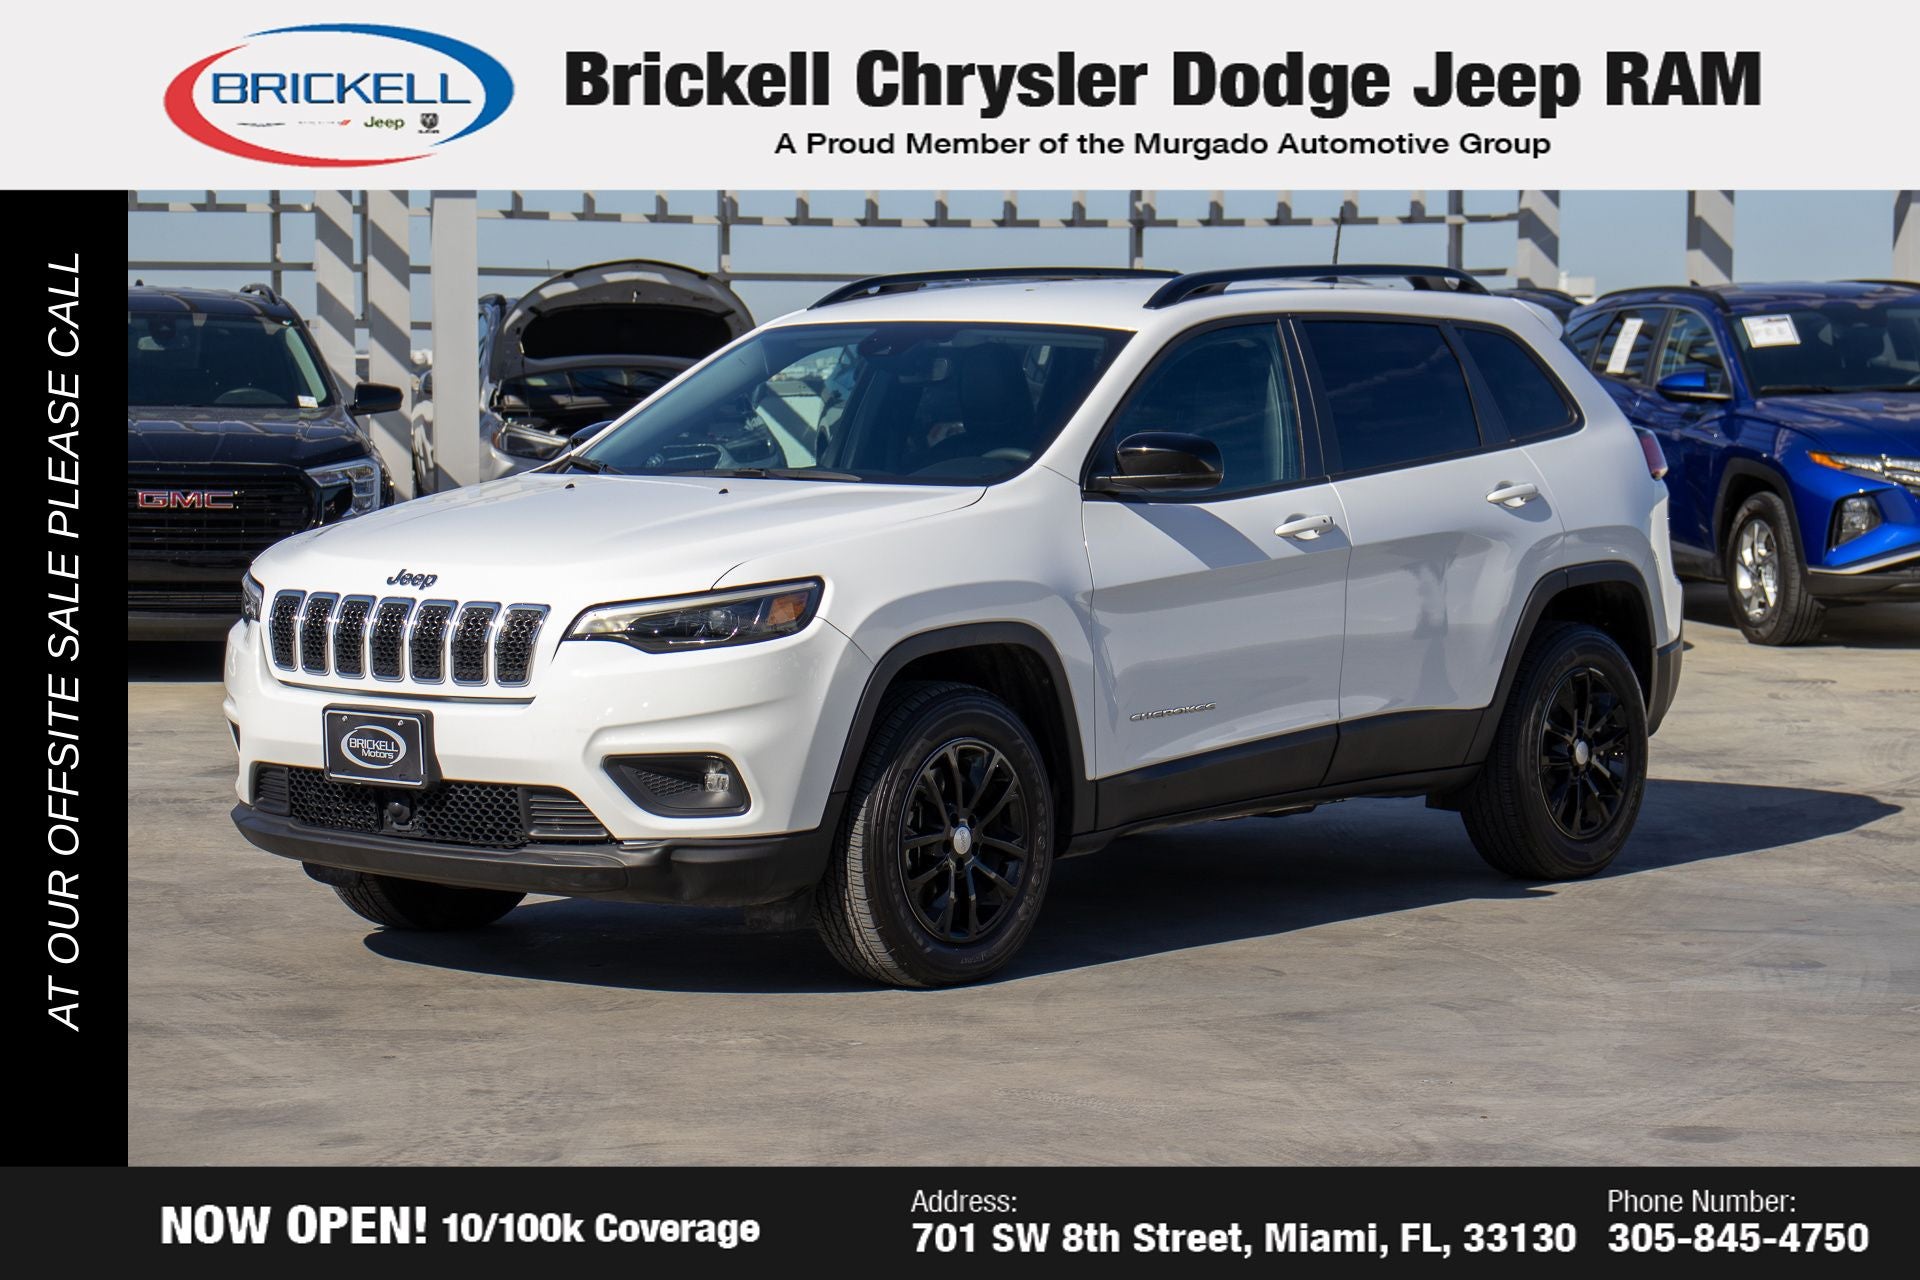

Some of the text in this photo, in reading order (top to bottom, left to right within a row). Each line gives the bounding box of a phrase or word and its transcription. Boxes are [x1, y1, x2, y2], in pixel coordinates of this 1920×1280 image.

[137, 490, 235, 509] GMC
[387, 569, 437, 590] Jeep
[349, 738, 399, 753] BRICKELL
[361, 749, 394, 760] Motors
